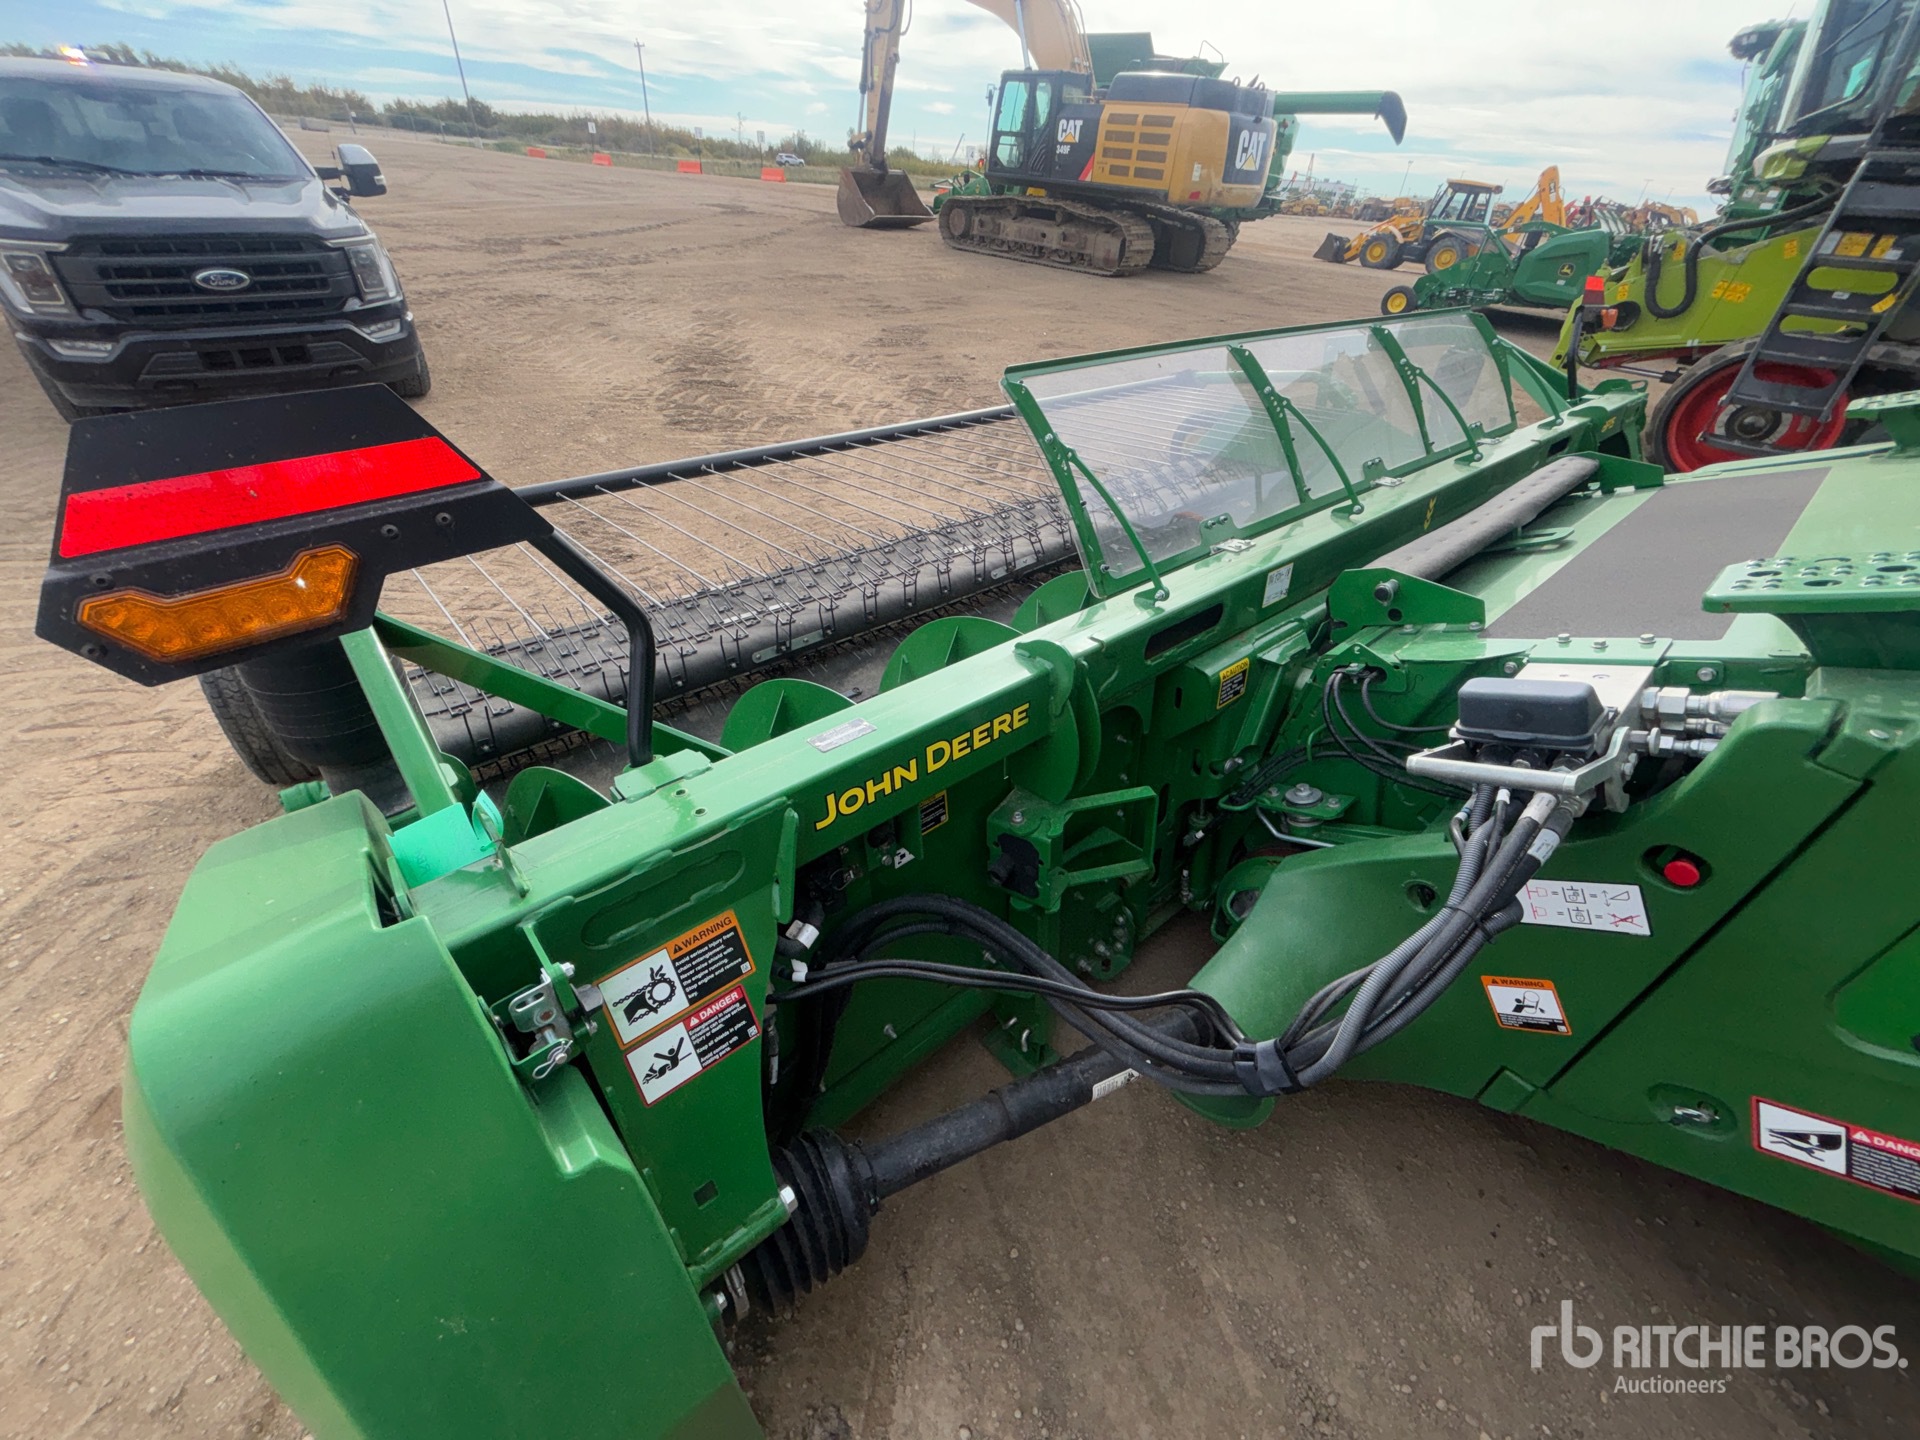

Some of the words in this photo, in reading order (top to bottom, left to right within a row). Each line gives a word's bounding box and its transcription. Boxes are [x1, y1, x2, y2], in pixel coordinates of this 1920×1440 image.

[1058, 119, 1083, 143] CAT
[1056, 145, 1071, 154] 349F
[1235, 129, 1267, 171] CAT
[209, 274, 238, 286] Ford
[815, 758, 917, 831] JOHN
[926, 702, 1030, 774] DEERE
[682, 916, 732, 945] WARNING
[1500, 979, 1545, 987] WARNING
[699, 991, 739, 1019] DANGER
